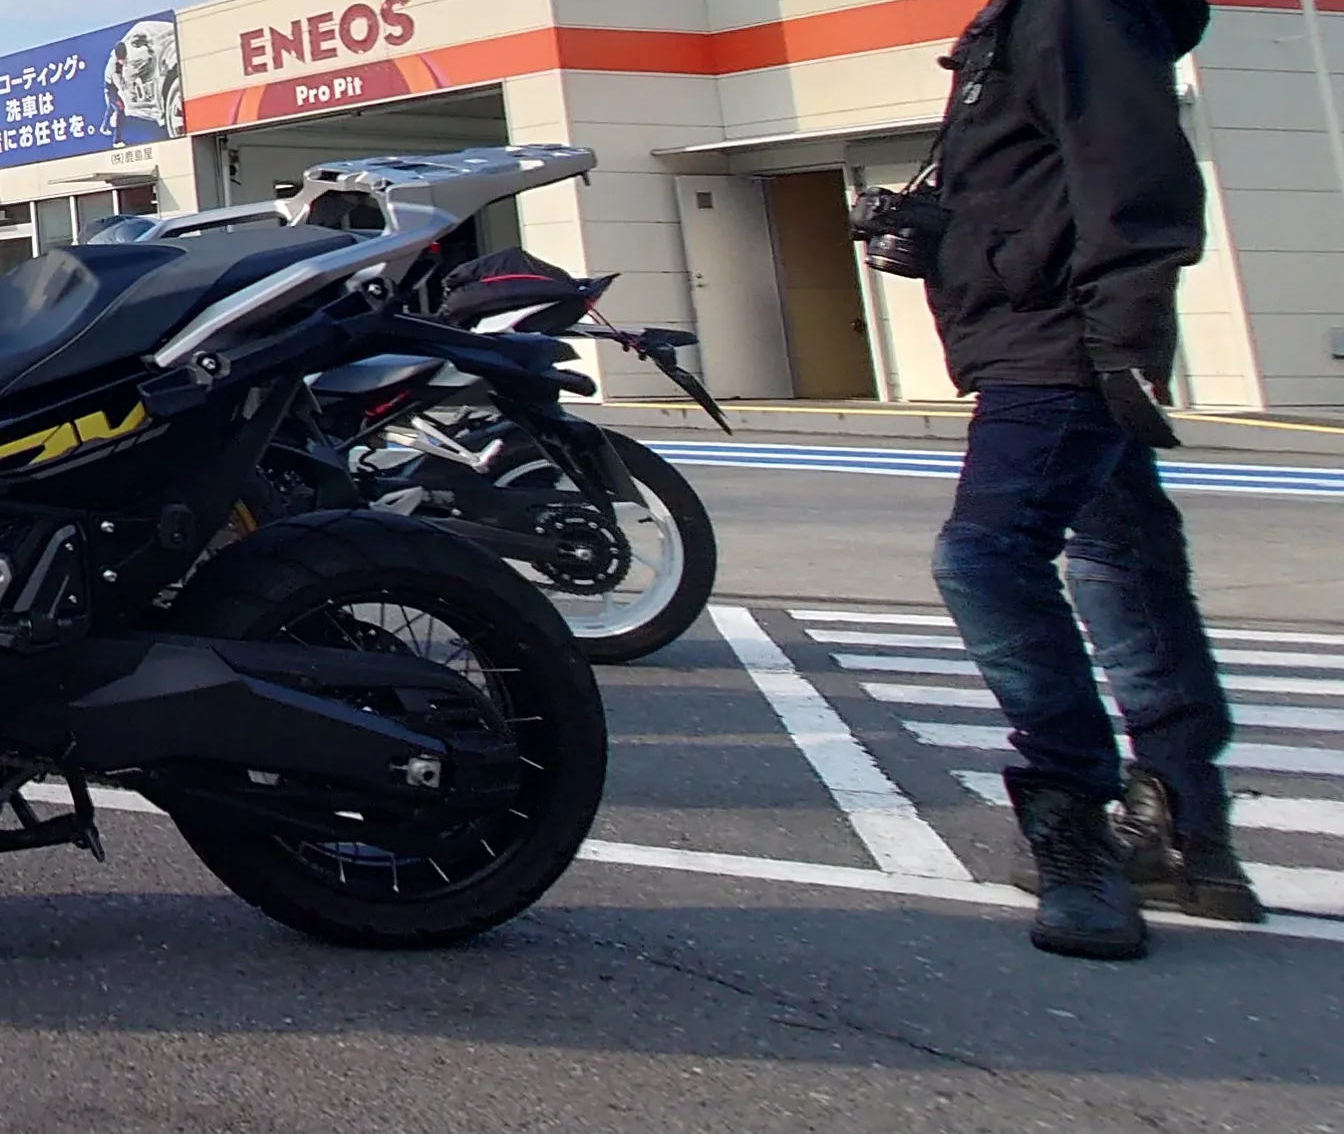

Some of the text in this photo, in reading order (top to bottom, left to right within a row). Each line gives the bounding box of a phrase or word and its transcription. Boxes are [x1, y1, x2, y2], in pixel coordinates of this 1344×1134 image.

[295, 76, 363, 106] Pro Pit
[5, 92, 55, 123] 洗車は
